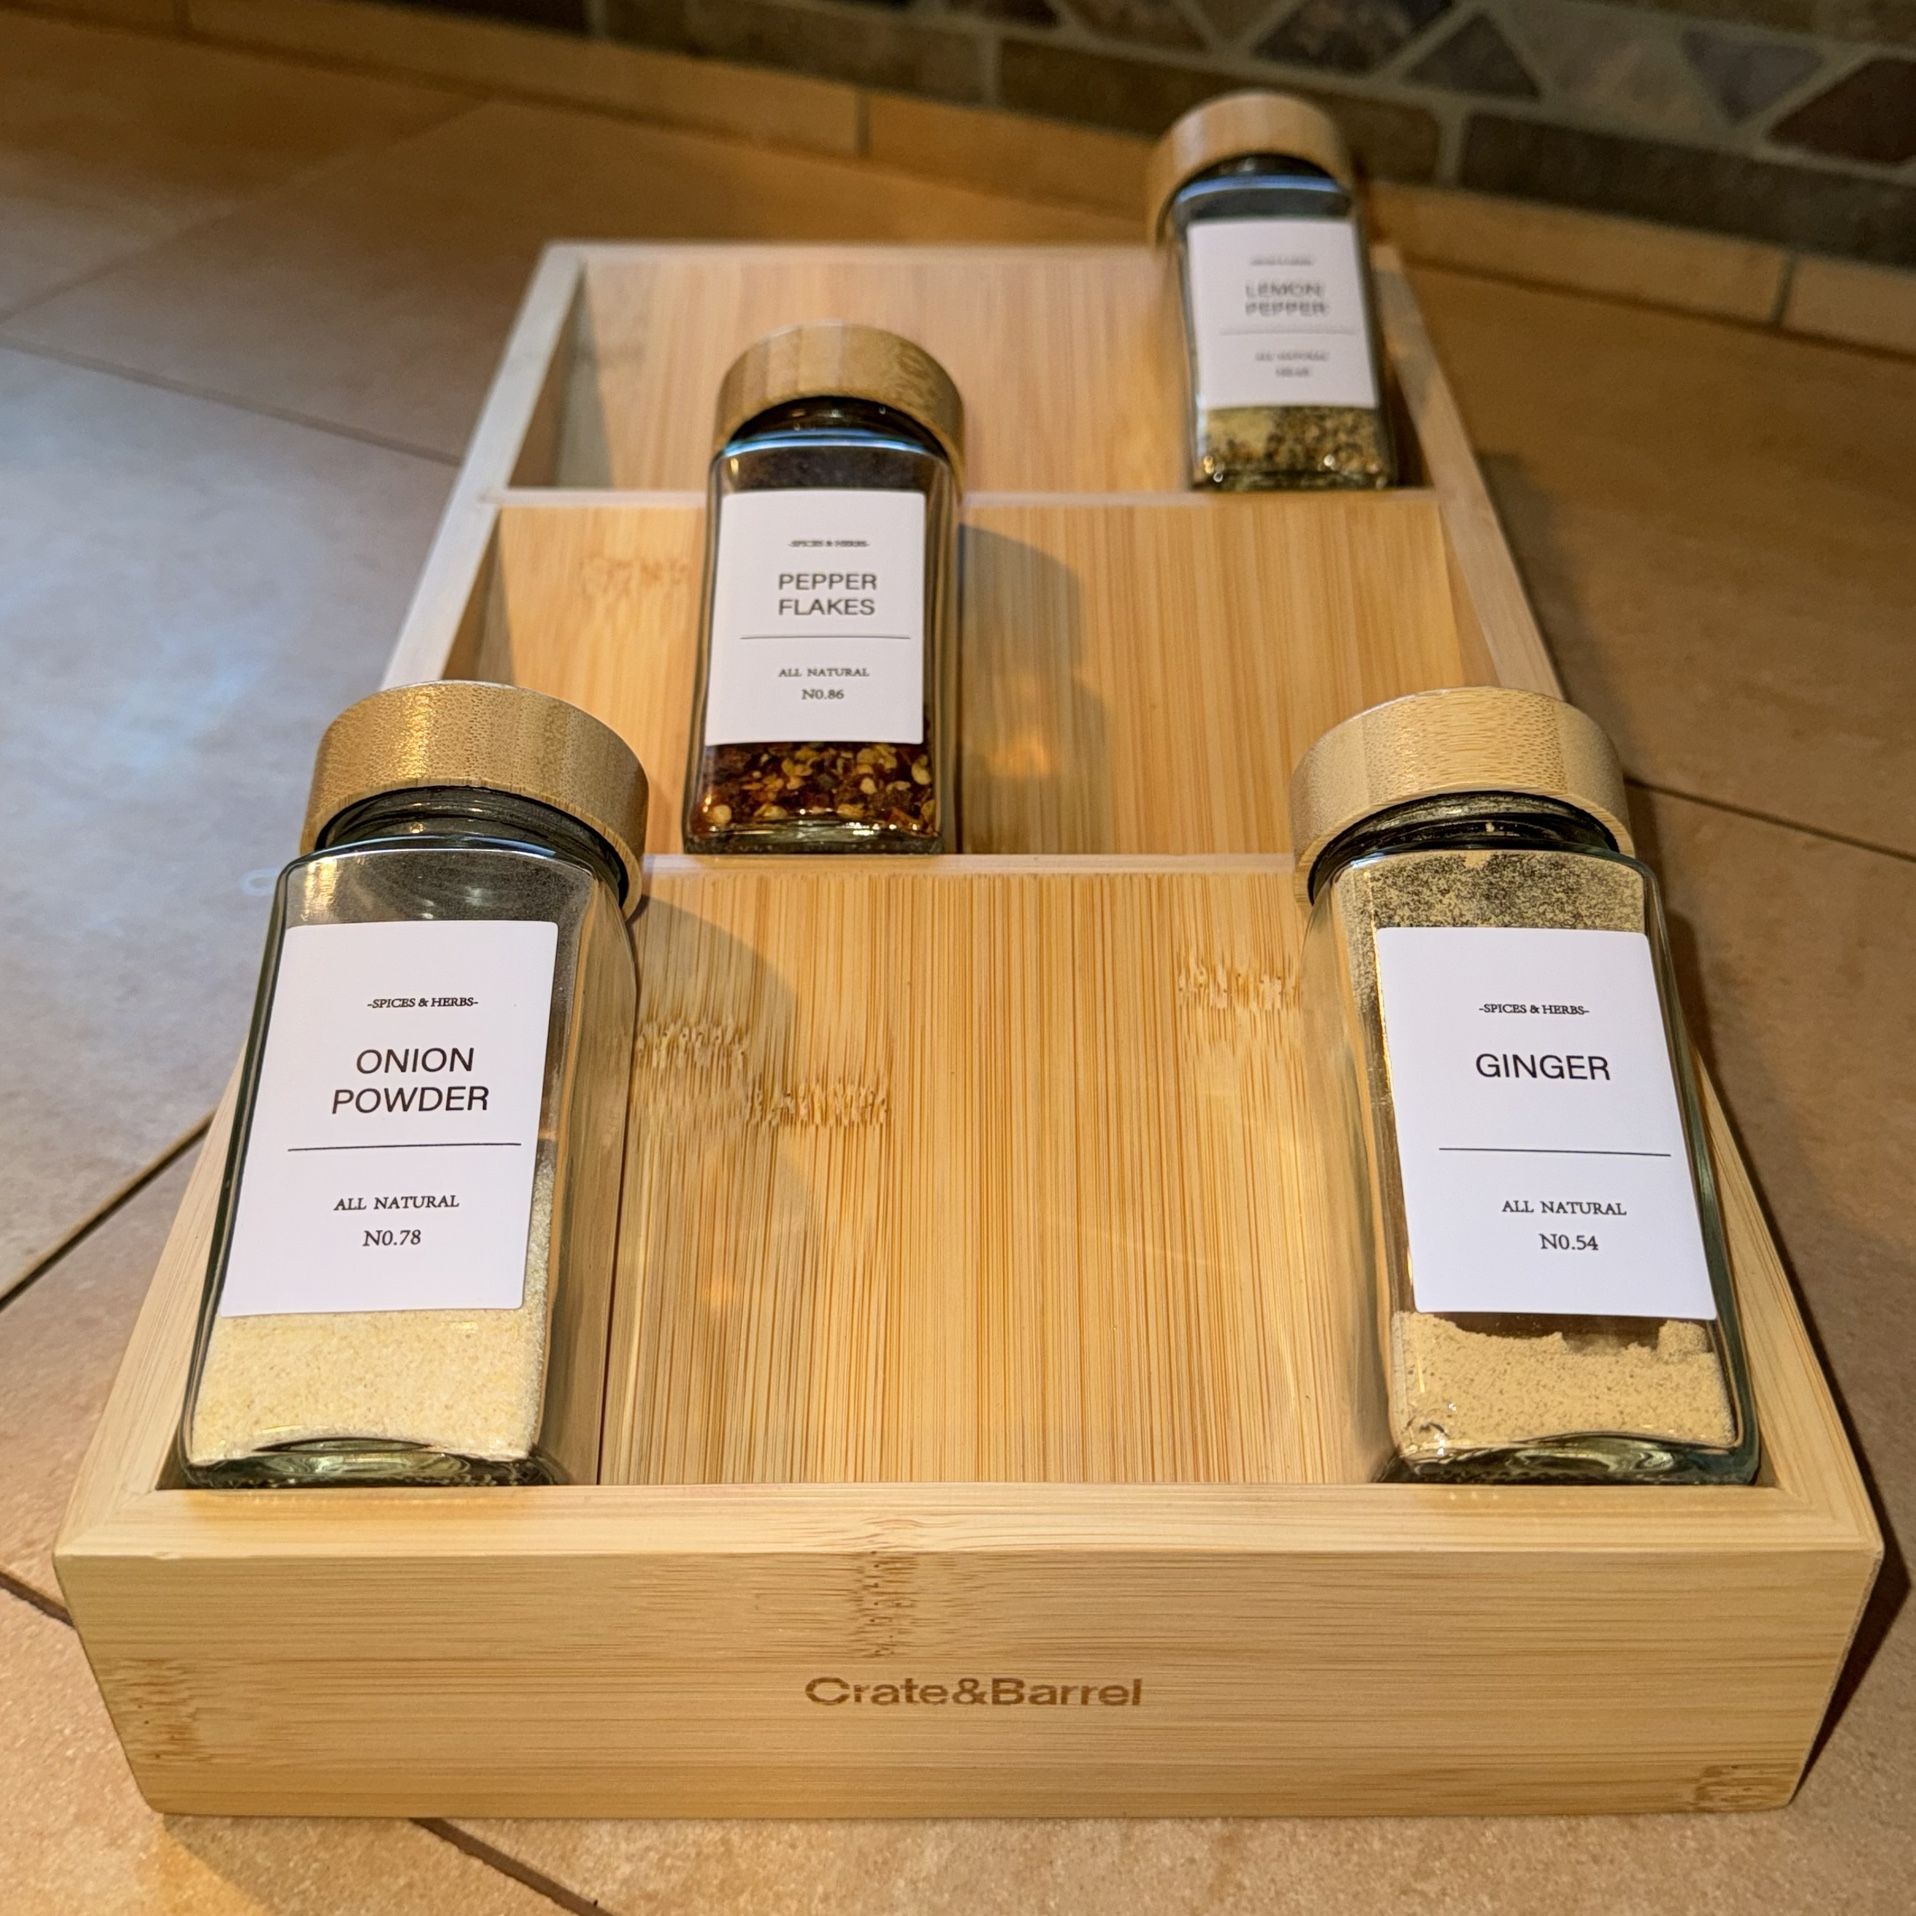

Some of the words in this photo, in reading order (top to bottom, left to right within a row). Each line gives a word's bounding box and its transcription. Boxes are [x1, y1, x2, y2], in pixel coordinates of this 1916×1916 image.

[1245, 283, 1323, 297] LEMON
[1245, 302, 1328, 316] PEPPER
[778, 573, 877, 590] PEPPER
[778, 598, 875, 616] FLAKES
[778, 668, 802, 677] ALL
[807, 668, 869, 677] NATURAL
[418, 997, 429, 1007] &
[1530, 1004, 1540, 1014] &
[356, 1047, 474, 1074] ONION
[1475, 1053, 1611, 1080] GINGER
[331, 1085, 489, 1114] POWDER
[333, 1197, 367, 1211] ALL
[374, 1195, 460, 1209] NATURAL
[1502, 1200, 1534, 1213] ALL
[1541, 1201, 1627, 1216] NATURAL
[805, 1676, 1143, 1706] Crate&Barrel
